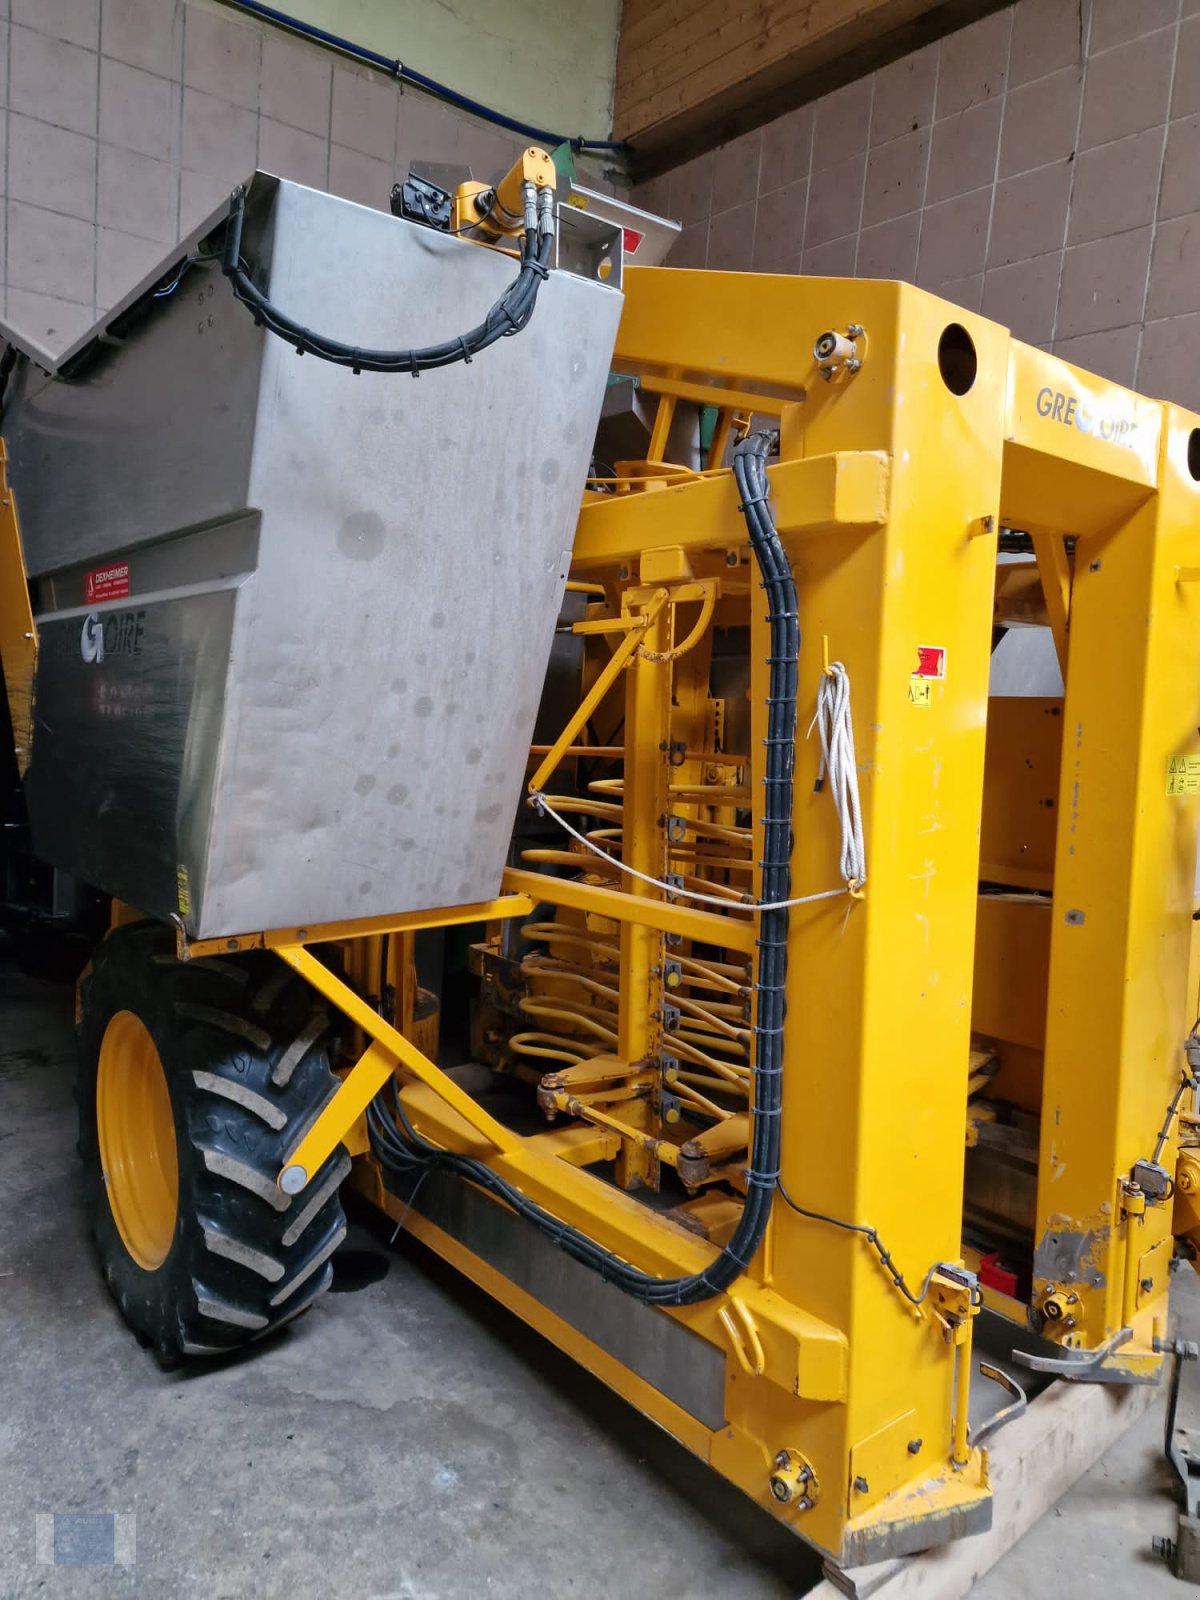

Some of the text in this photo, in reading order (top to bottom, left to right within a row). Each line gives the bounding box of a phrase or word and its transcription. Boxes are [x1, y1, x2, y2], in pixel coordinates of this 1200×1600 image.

[1036, 386, 1138, 448] GREOIR
[95, 566, 129, 584] DEXHEIMER
[56, 611, 146, 664] GOIRE
